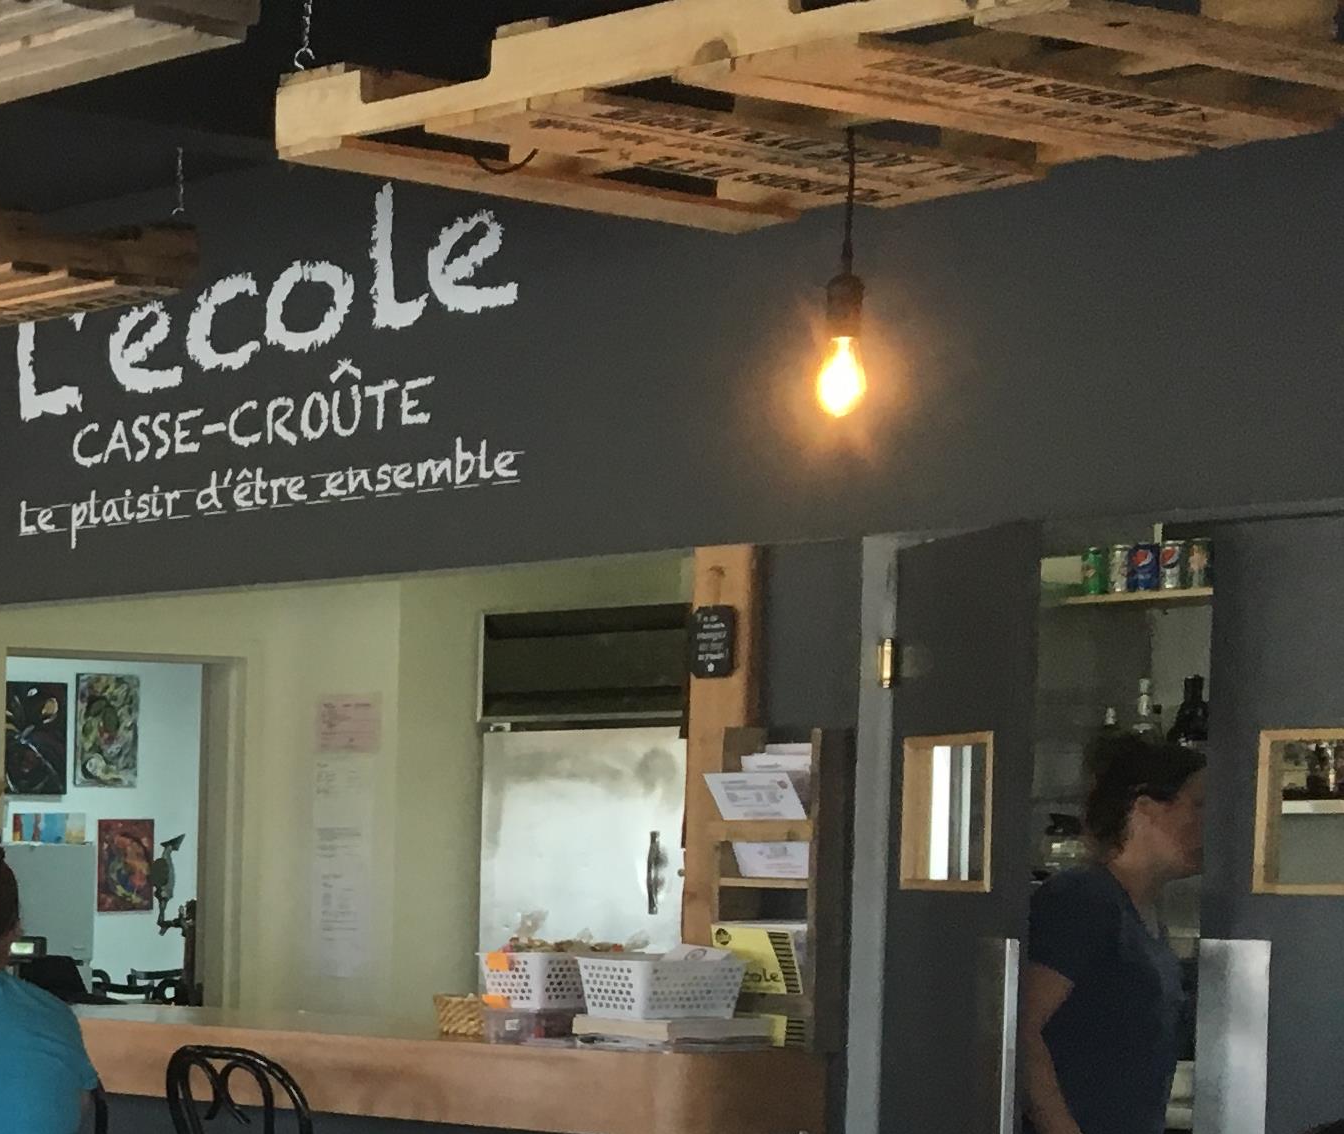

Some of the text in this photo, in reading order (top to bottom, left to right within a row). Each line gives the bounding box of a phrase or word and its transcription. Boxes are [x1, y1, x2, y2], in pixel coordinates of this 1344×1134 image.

[71, 358, 436, 468] CASSE-CROÛTE
[19, 438, 521, 549] Le plaisir d'être ensemble
